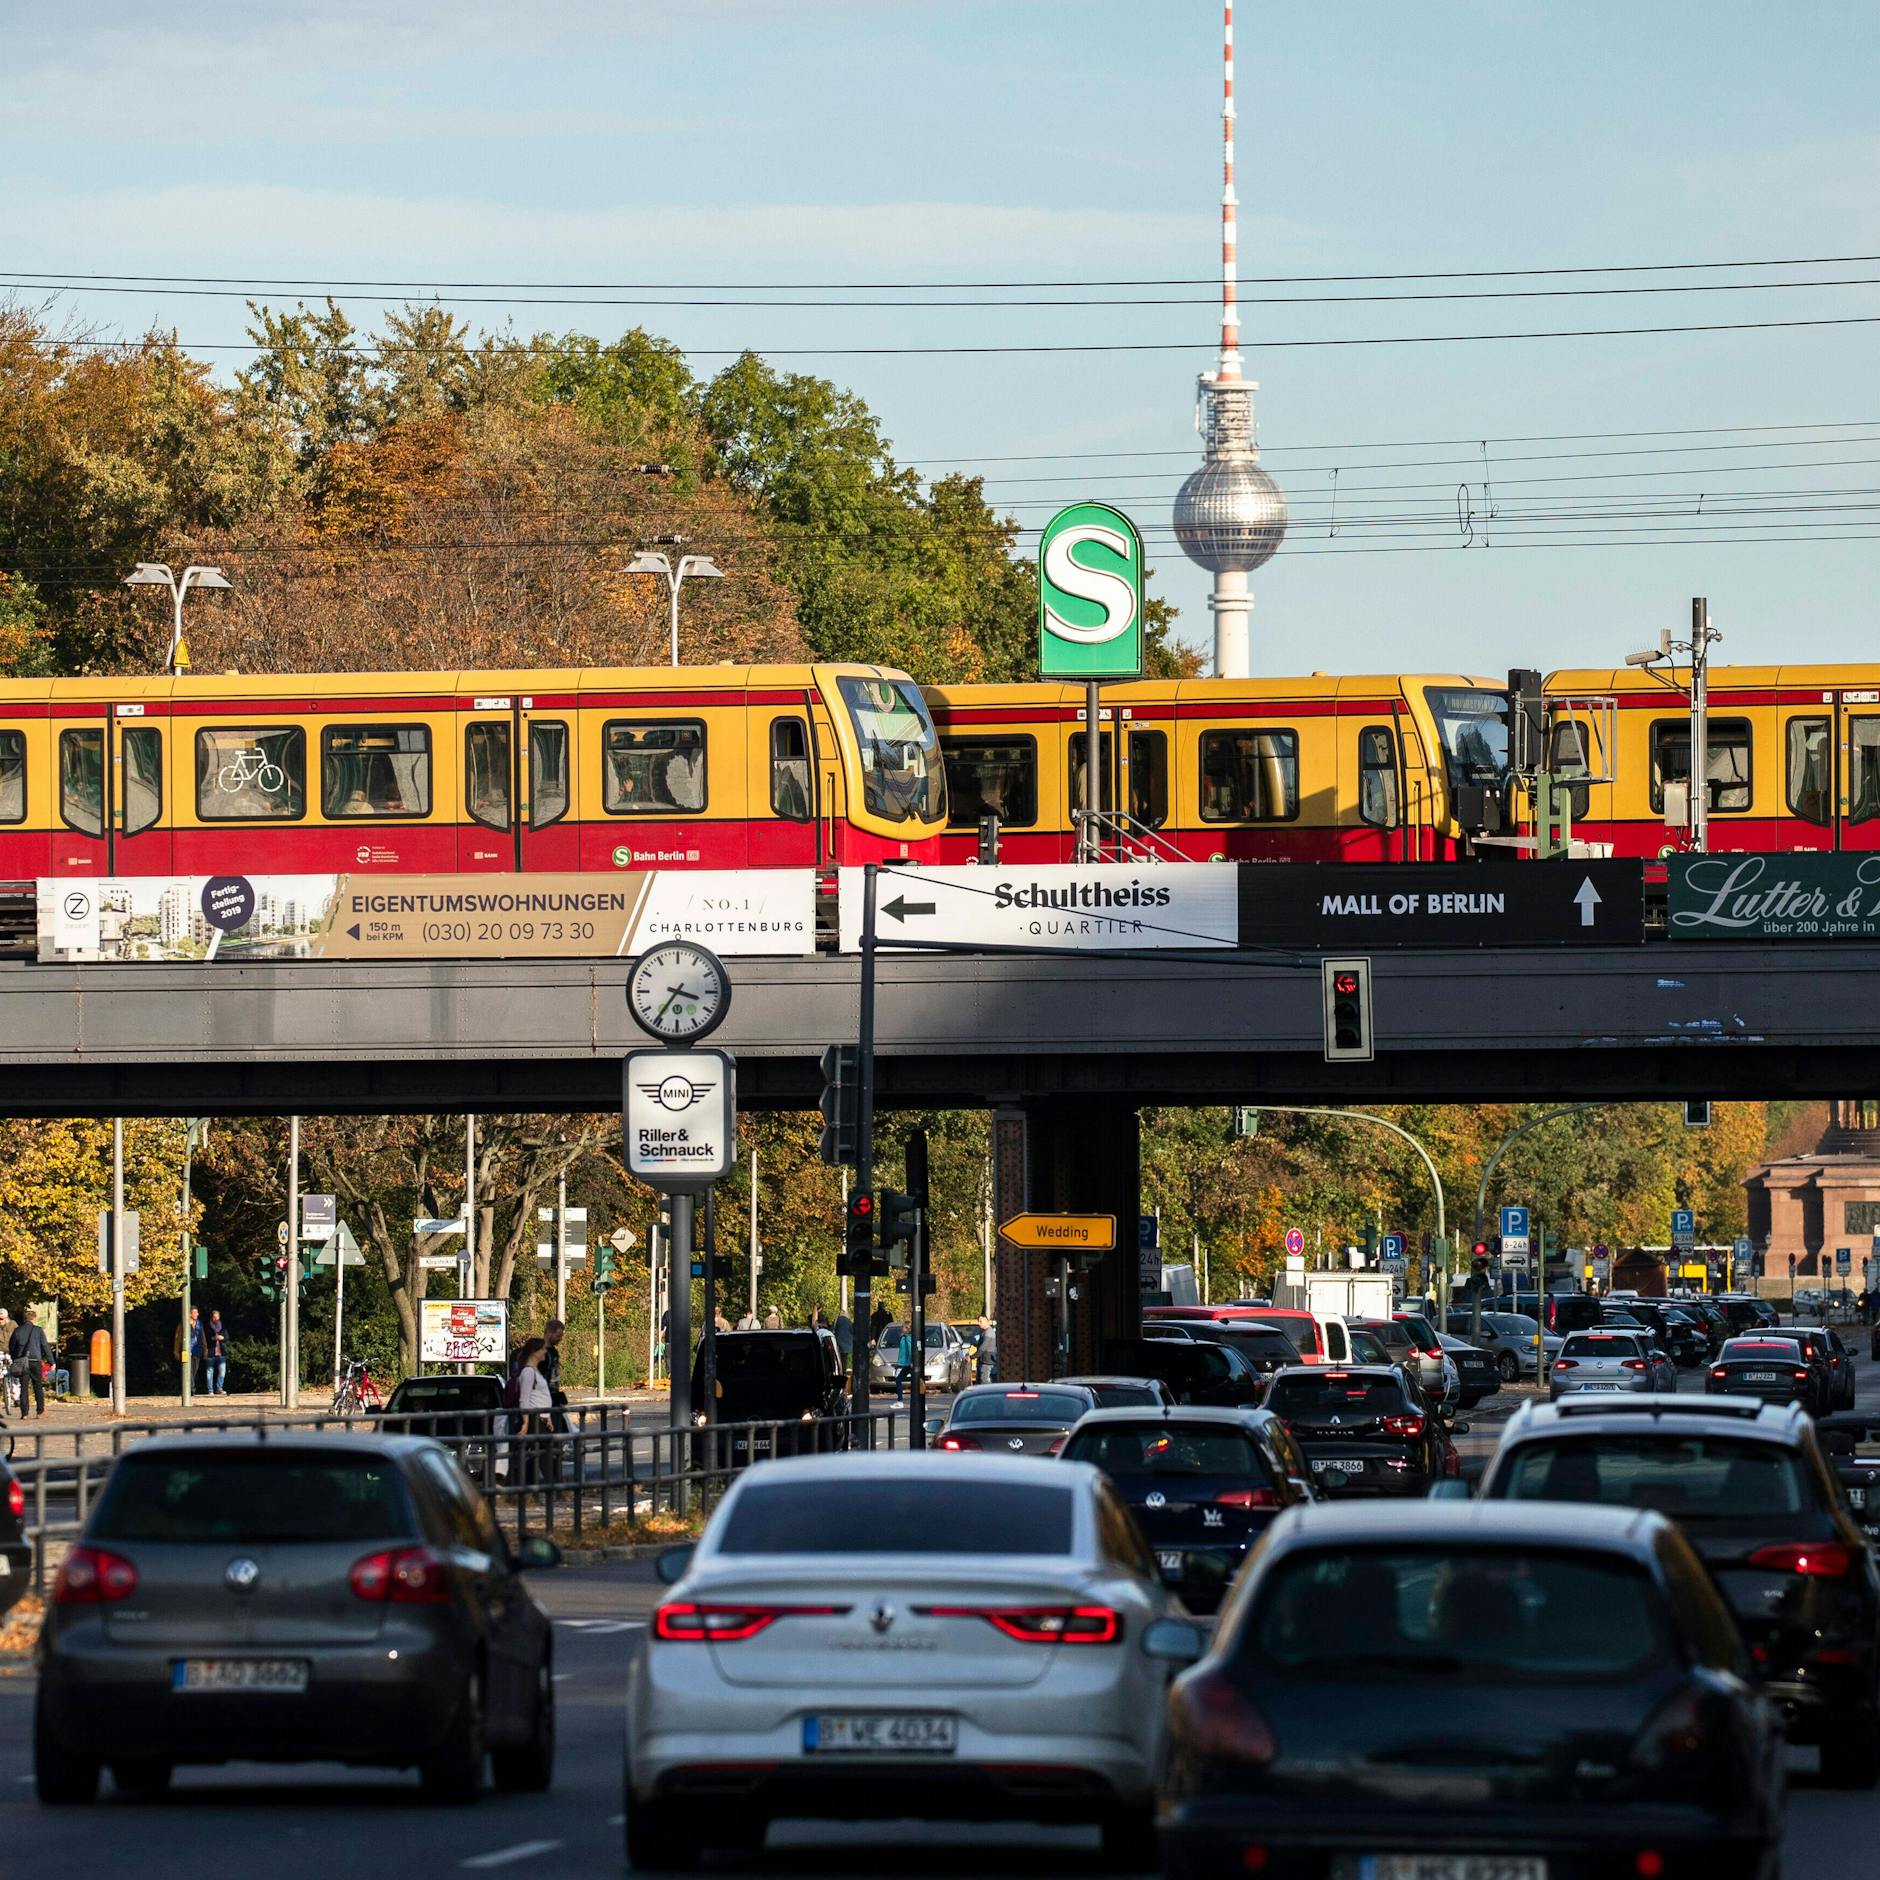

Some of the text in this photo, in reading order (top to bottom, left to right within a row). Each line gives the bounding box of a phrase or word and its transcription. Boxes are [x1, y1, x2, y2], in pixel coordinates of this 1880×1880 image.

[1044, 525, 1136, 645] S
[633, 851, 656, 861] Bahn
[658, 850, 684, 861] Berlin
[210, 883, 240, 899] Fertig-
[994, 879, 1171, 909] Schultheiss
[1672, 857, 1829, 928] Lutter
[1836, 887, 1863, 917] &
[211, 894, 246, 911] stellung
[351, 893, 625, 913] EIGENTUMSWOHNUNGEN
[1321, 893, 1505, 915] MALL OF BERLIN
[220, 906, 242, 920] 2019
[369, 922, 388, 932] 150
[422, 922, 594, 943] (030) 20 09 73 30
[649, 921, 803, 933] CHARLOTTENBURG
[1764, 920, 1875, 933] über 200 Jahre in
[366, 932, 403, 941] bei KPM
[663, 1089, 689, 1099] MINI
[639, 1143, 714, 1156] Schnauck
[1508, 1212, 1522, 1233] P
[1676, 1213, 1689, 1230] P
[1036, 1225, 1088, 1241] Wedding
[1386, 1238, 1396, 1257] P
[1739, 1241, 1749, 1257] P
